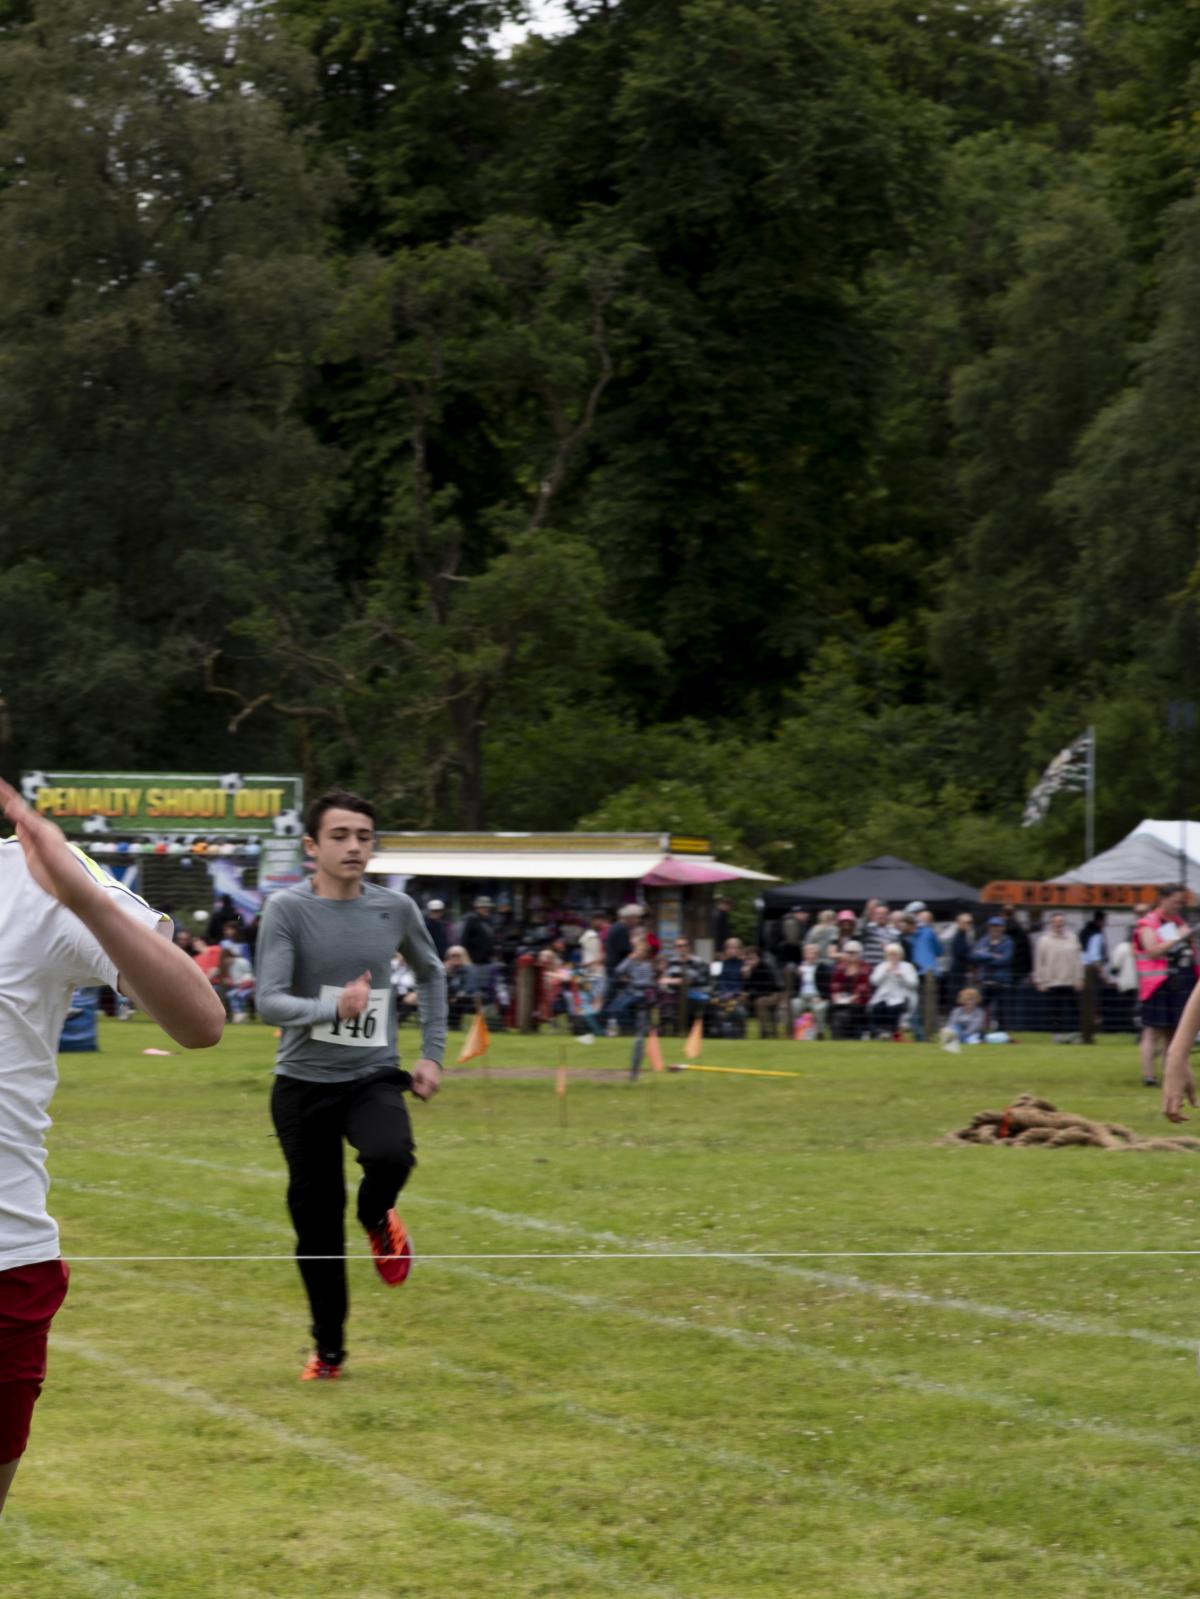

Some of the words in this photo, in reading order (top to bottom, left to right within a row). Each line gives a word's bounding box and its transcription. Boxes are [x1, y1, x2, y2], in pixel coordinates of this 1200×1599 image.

[36, 788, 142, 816] PENALTY
[146, 788, 228, 817] SHOOT
[234, 789, 284, 817] OUT
[1023, 886, 1069, 902] HOT
[330, 1008, 377, 1039] 146
